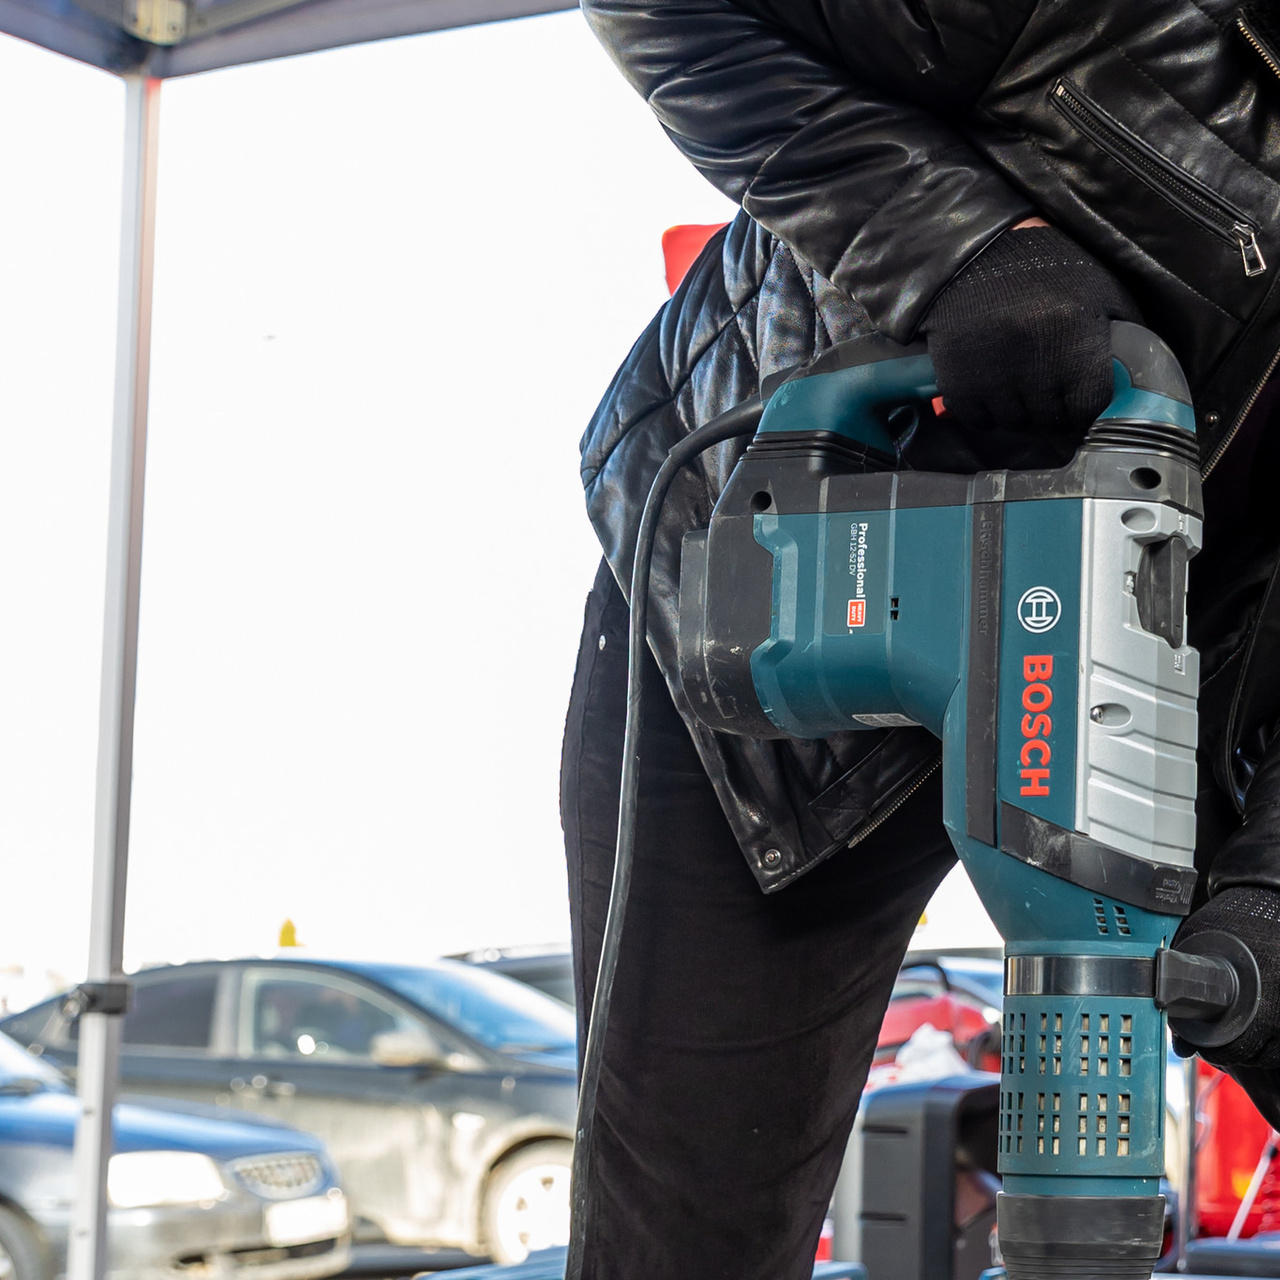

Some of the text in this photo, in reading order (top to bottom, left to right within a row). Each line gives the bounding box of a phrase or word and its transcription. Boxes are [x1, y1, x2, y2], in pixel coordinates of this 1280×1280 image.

[848, 522, 858, 576] GBH 12-52 DV
[855, 522, 869, 599] Professional
[1020, 654, 1054, 797] BOSCH
